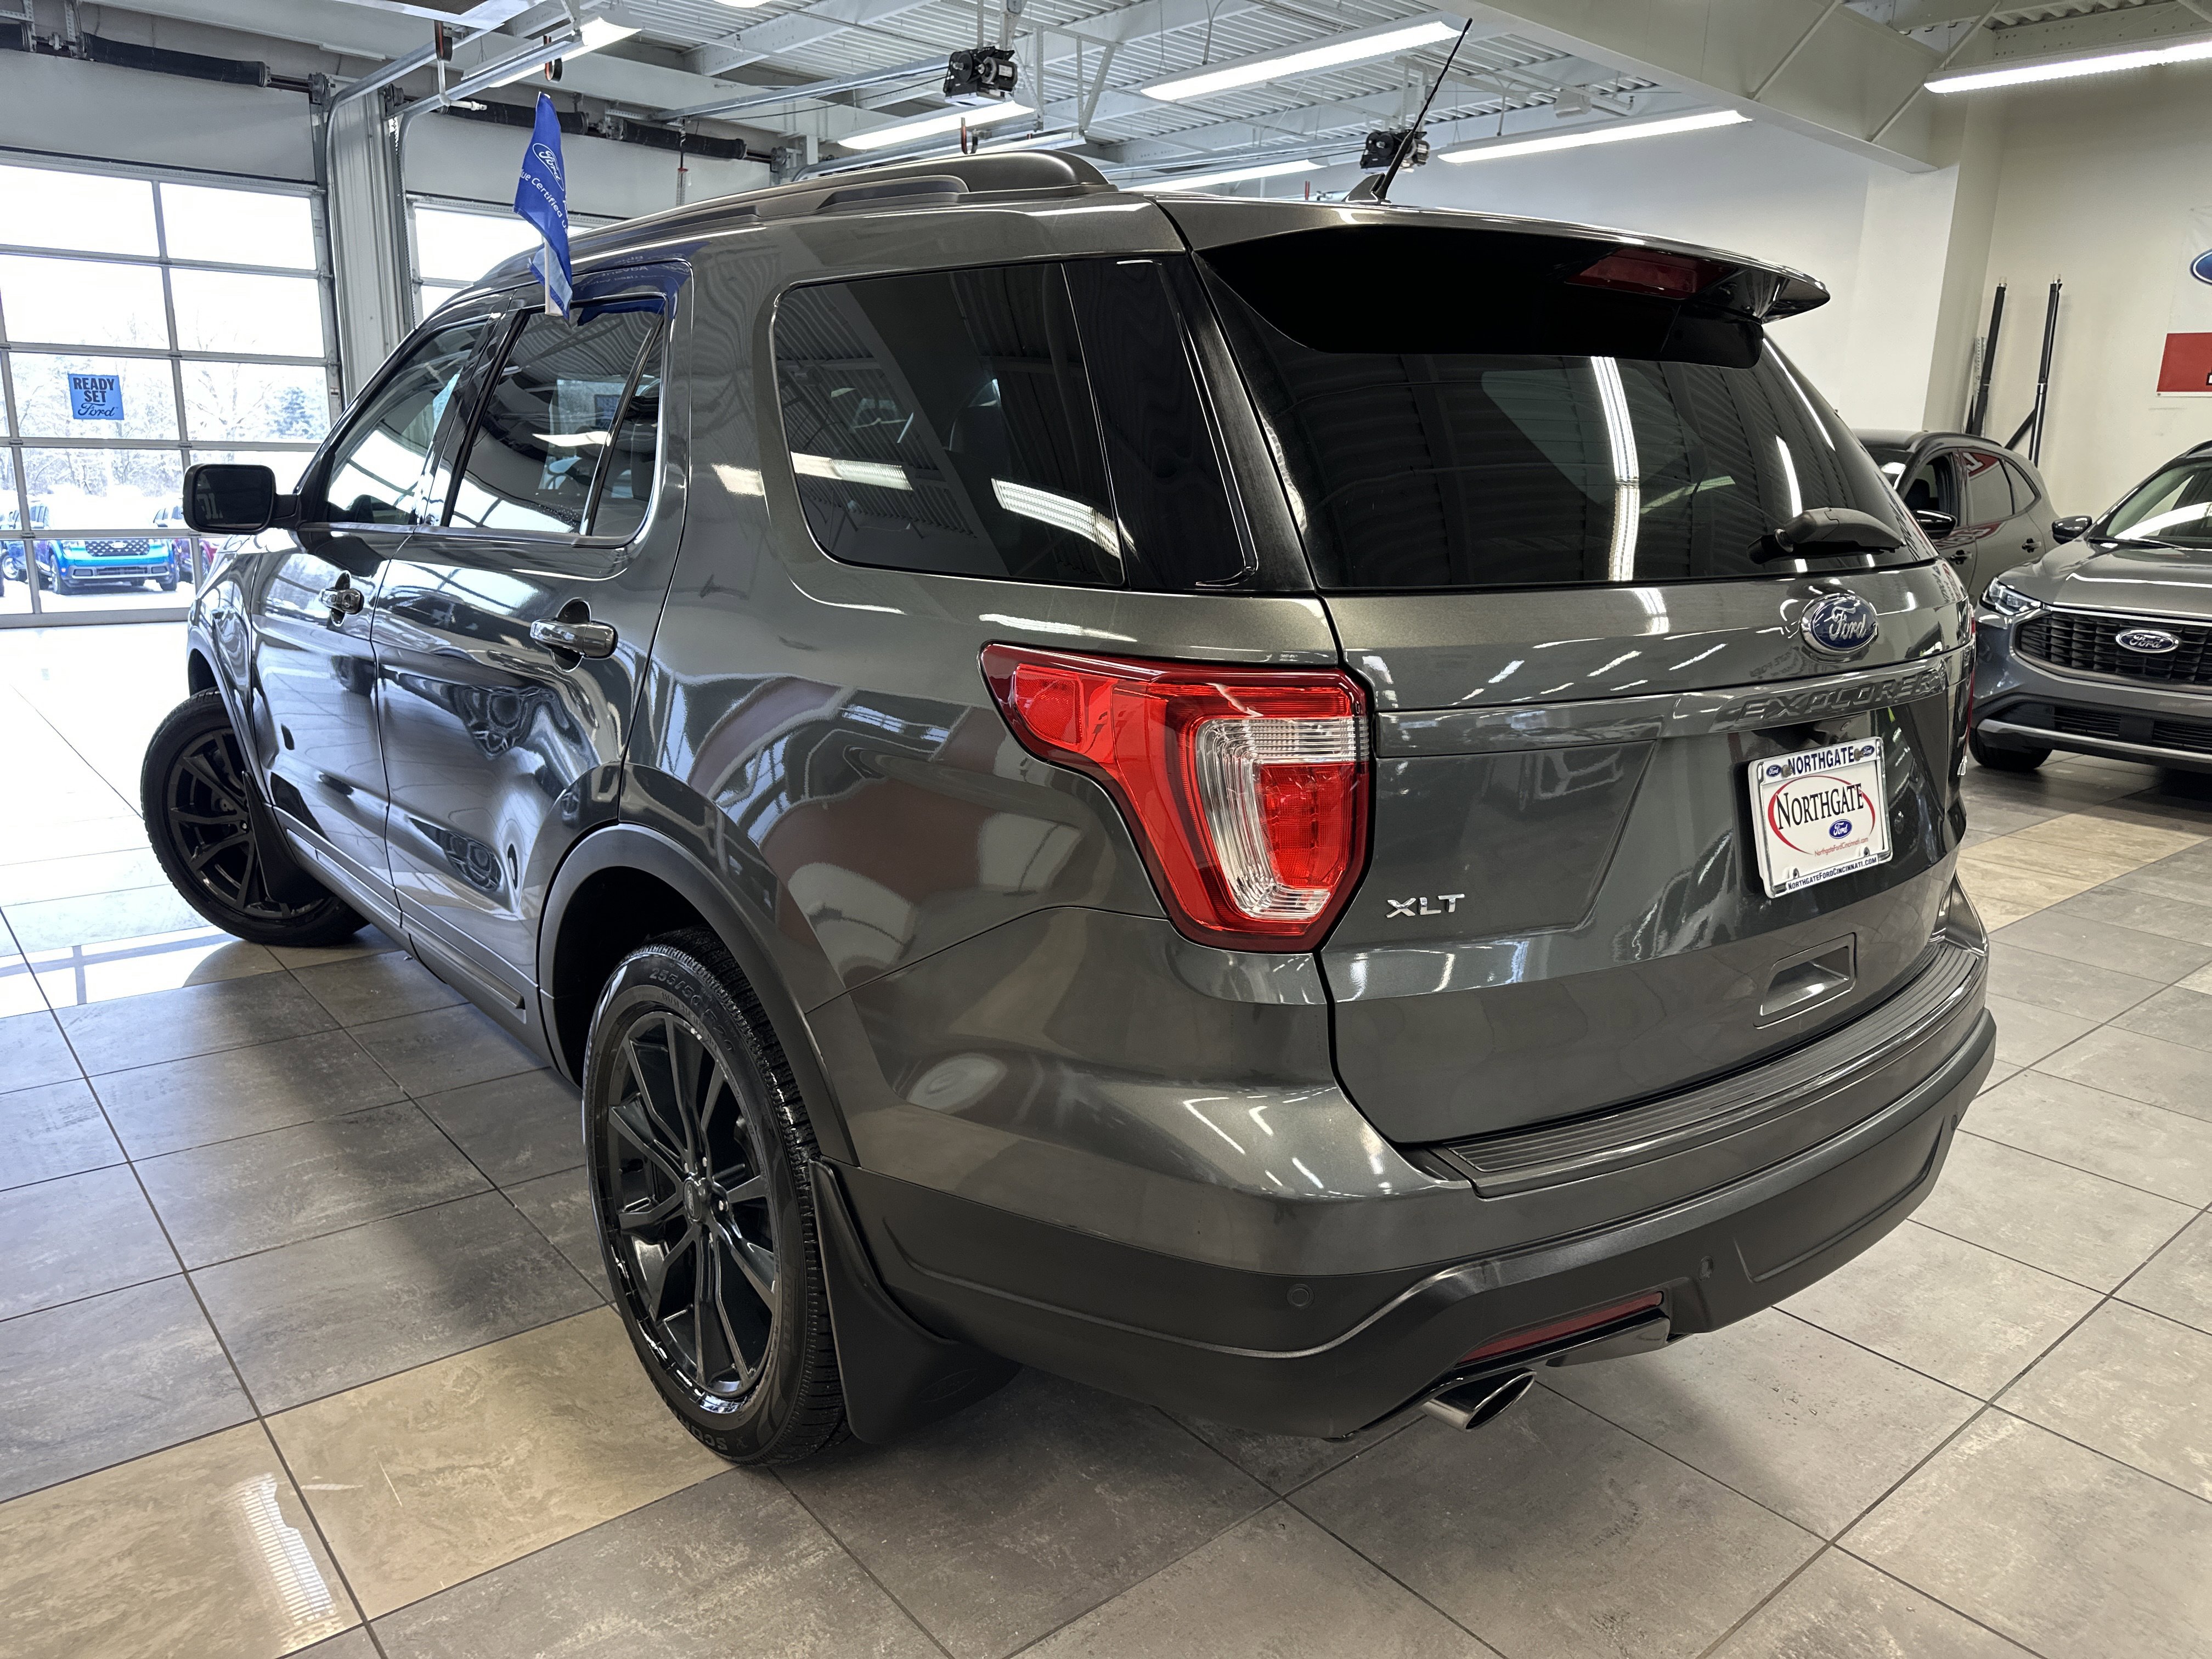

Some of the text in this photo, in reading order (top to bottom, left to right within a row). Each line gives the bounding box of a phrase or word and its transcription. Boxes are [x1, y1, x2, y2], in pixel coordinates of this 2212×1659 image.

[539, 150, 561, 180] Ford
[521, 169, 563, 218] ue Certified
[73, 377, 114, 391] READY
[84, 391, 106, 402] SET
[1829, 606, 1866, 641] Ford
[2129, 634, 2163, 648] Ford
[1735, 668, 1942, 721] EXPLORER
[1788, 746, 1855, 775] NORTHGATE
[1776, 783, 1864, 830] NORTHGATE
[1833, 822, 1848, 836] Ford
[1386, 894, 1465, 918] XLT
